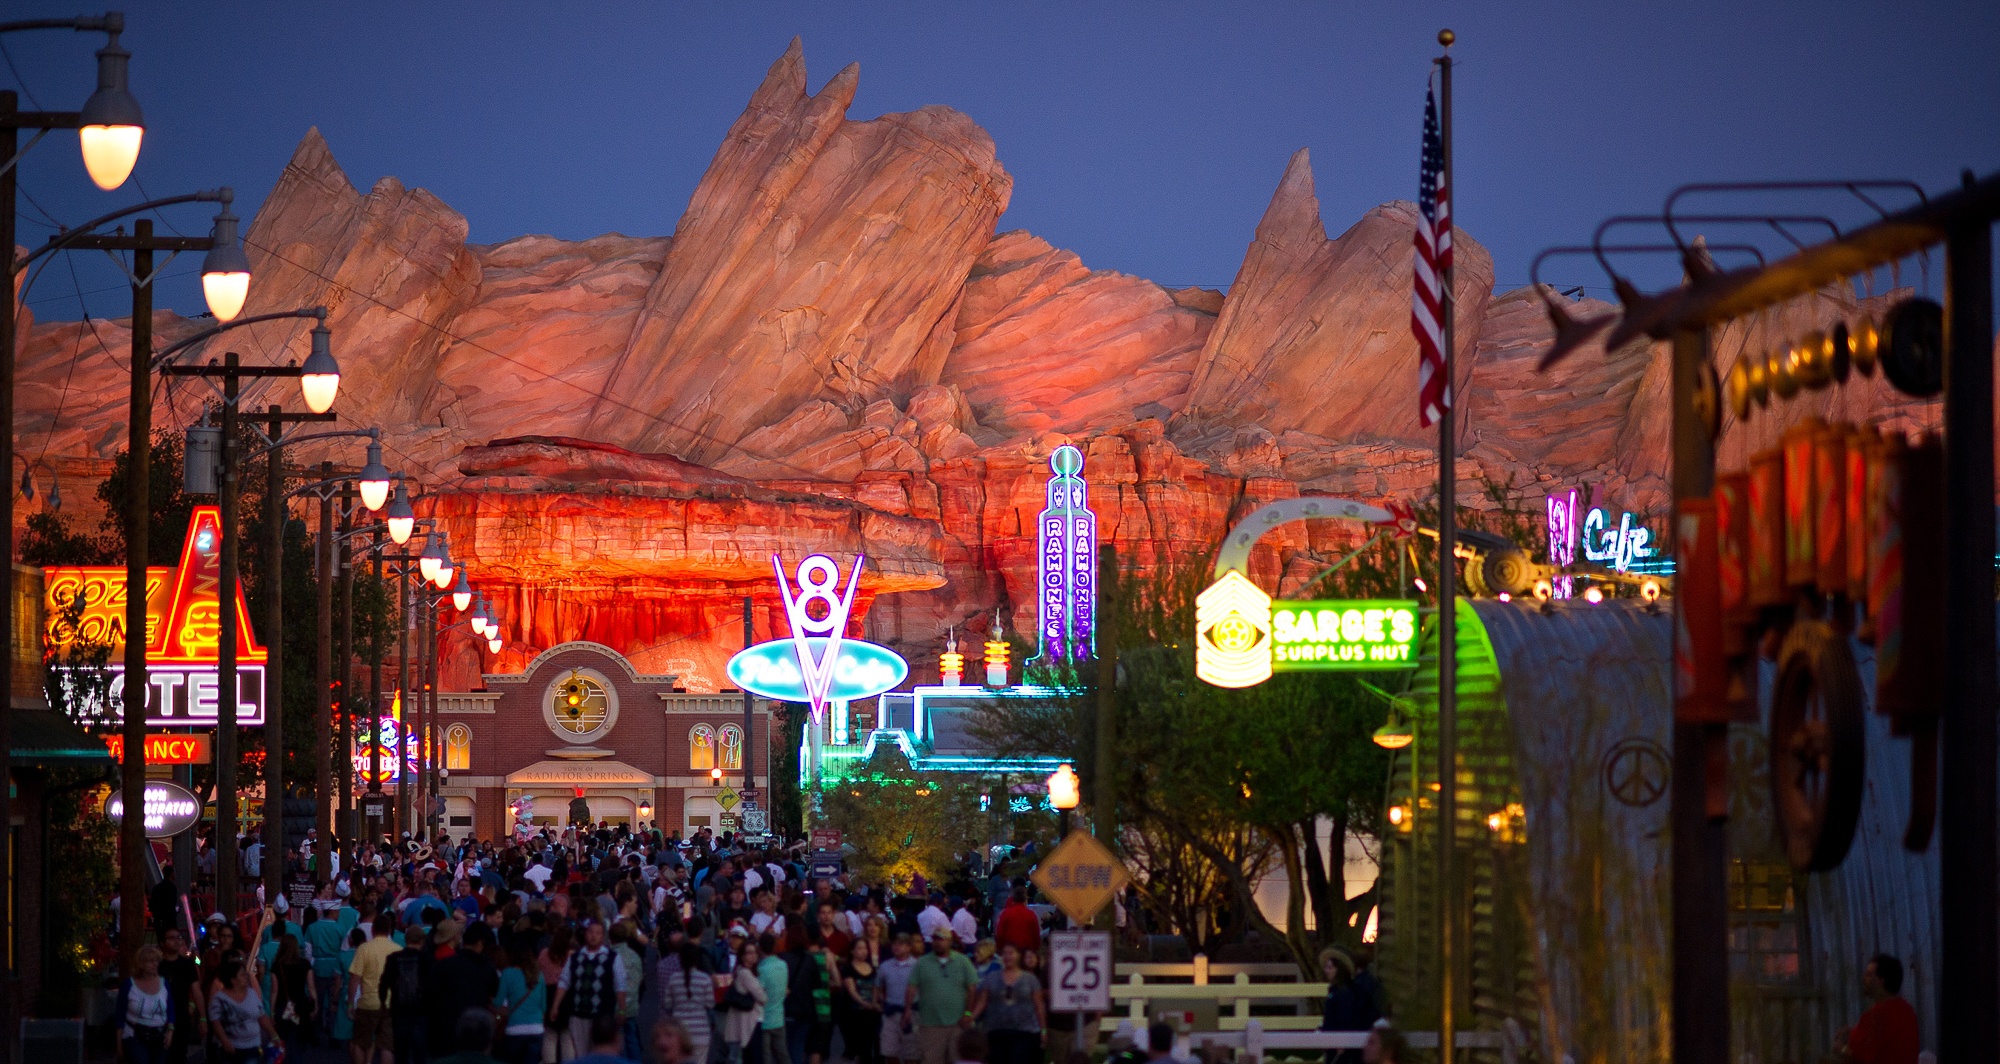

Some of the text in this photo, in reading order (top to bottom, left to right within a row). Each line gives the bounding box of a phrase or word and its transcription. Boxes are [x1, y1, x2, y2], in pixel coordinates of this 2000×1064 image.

[1582, 508, 1654, 573] Cafe
[1046, 519, 1062, 638] RAMONES
[1273, 608, 1415, 643] SARGE'S
[1275, 644, 1410, 661] SURPLUS HUT
[109, 740, 195, 759] ANCY
[353, 756, 400, 771] TIES
[526, 772, 634, 780] RADIATOR SPRINGS
[747, 818, 764, 829] 66
[1049, 864, 1112, 888] SLOW
[1060, 955, 1100, 990] 25
[136, 995, 167, 1021] LA
